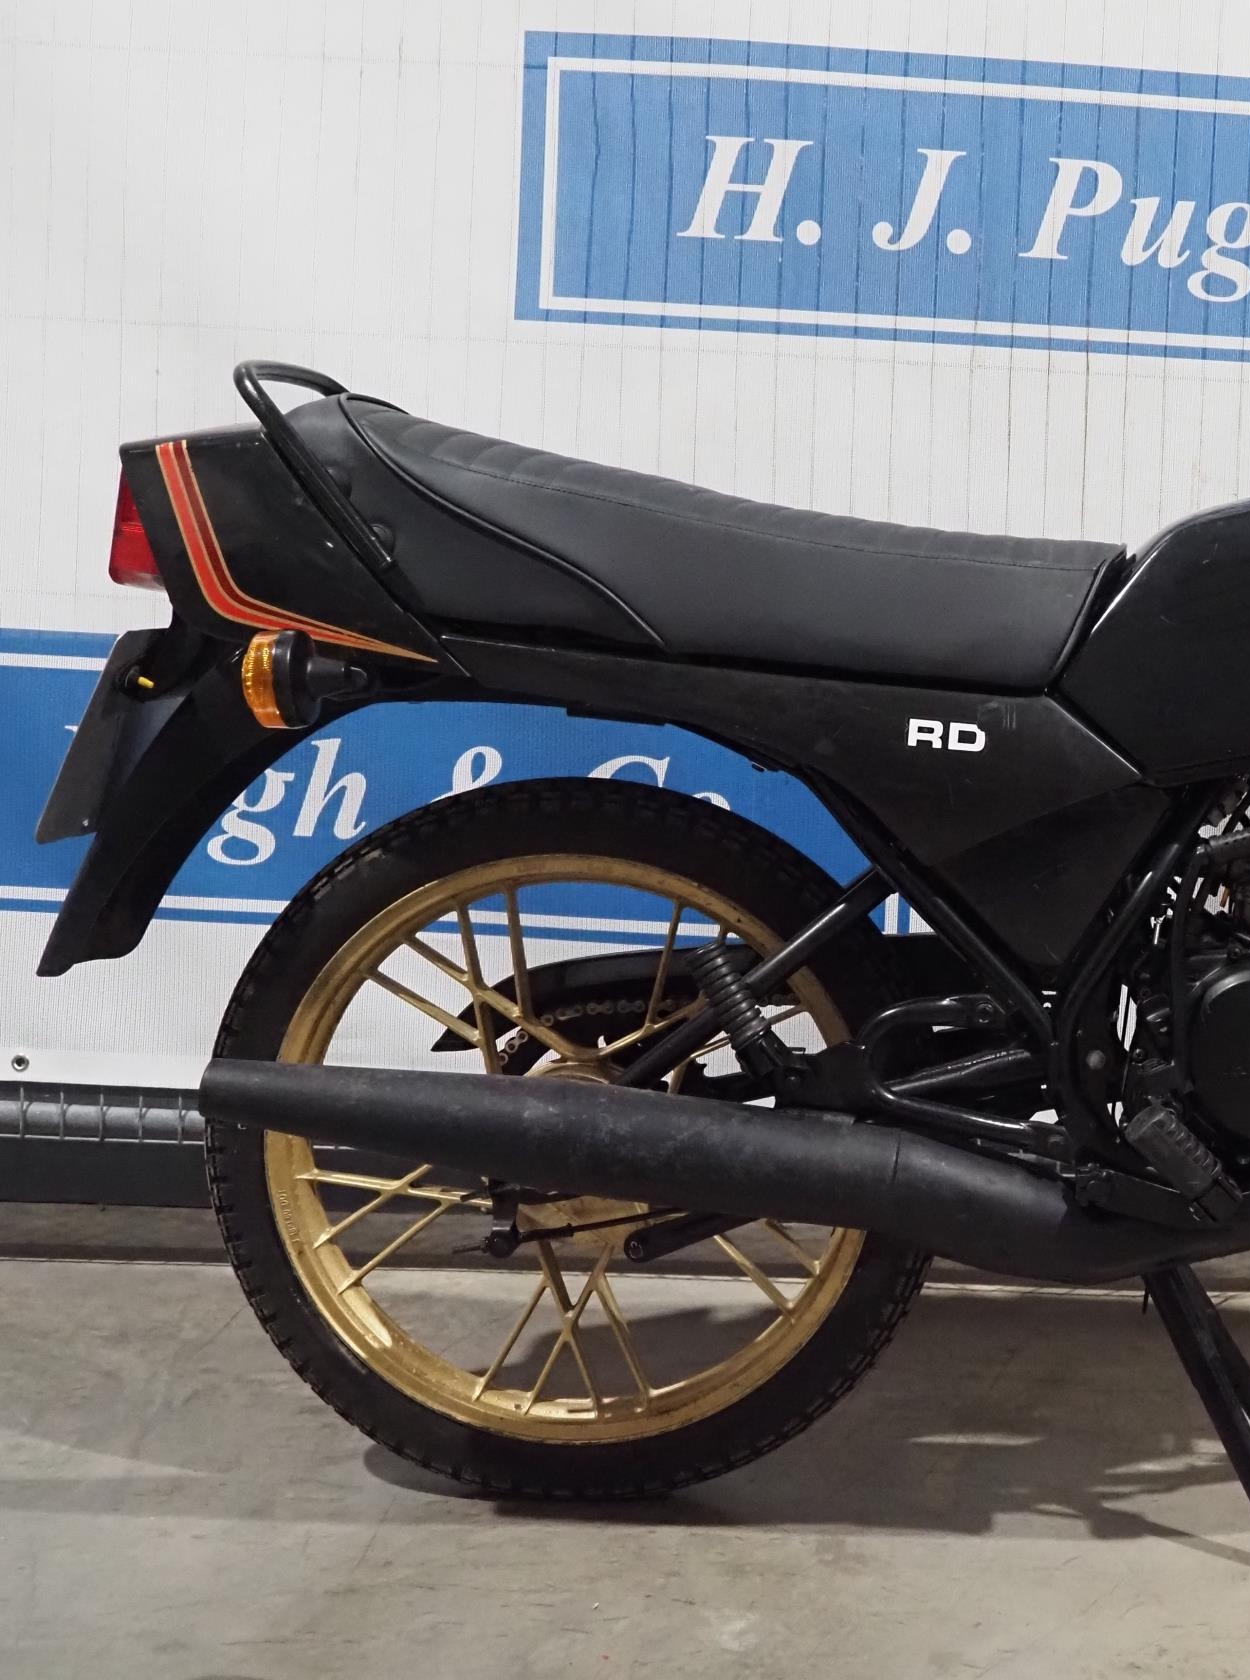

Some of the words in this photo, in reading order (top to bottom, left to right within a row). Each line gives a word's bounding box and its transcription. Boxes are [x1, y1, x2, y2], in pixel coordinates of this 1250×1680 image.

[677, 135, 822, 245] H.
[872, 148, 972, 254] J.
[907, 718, 986, 752] RD
